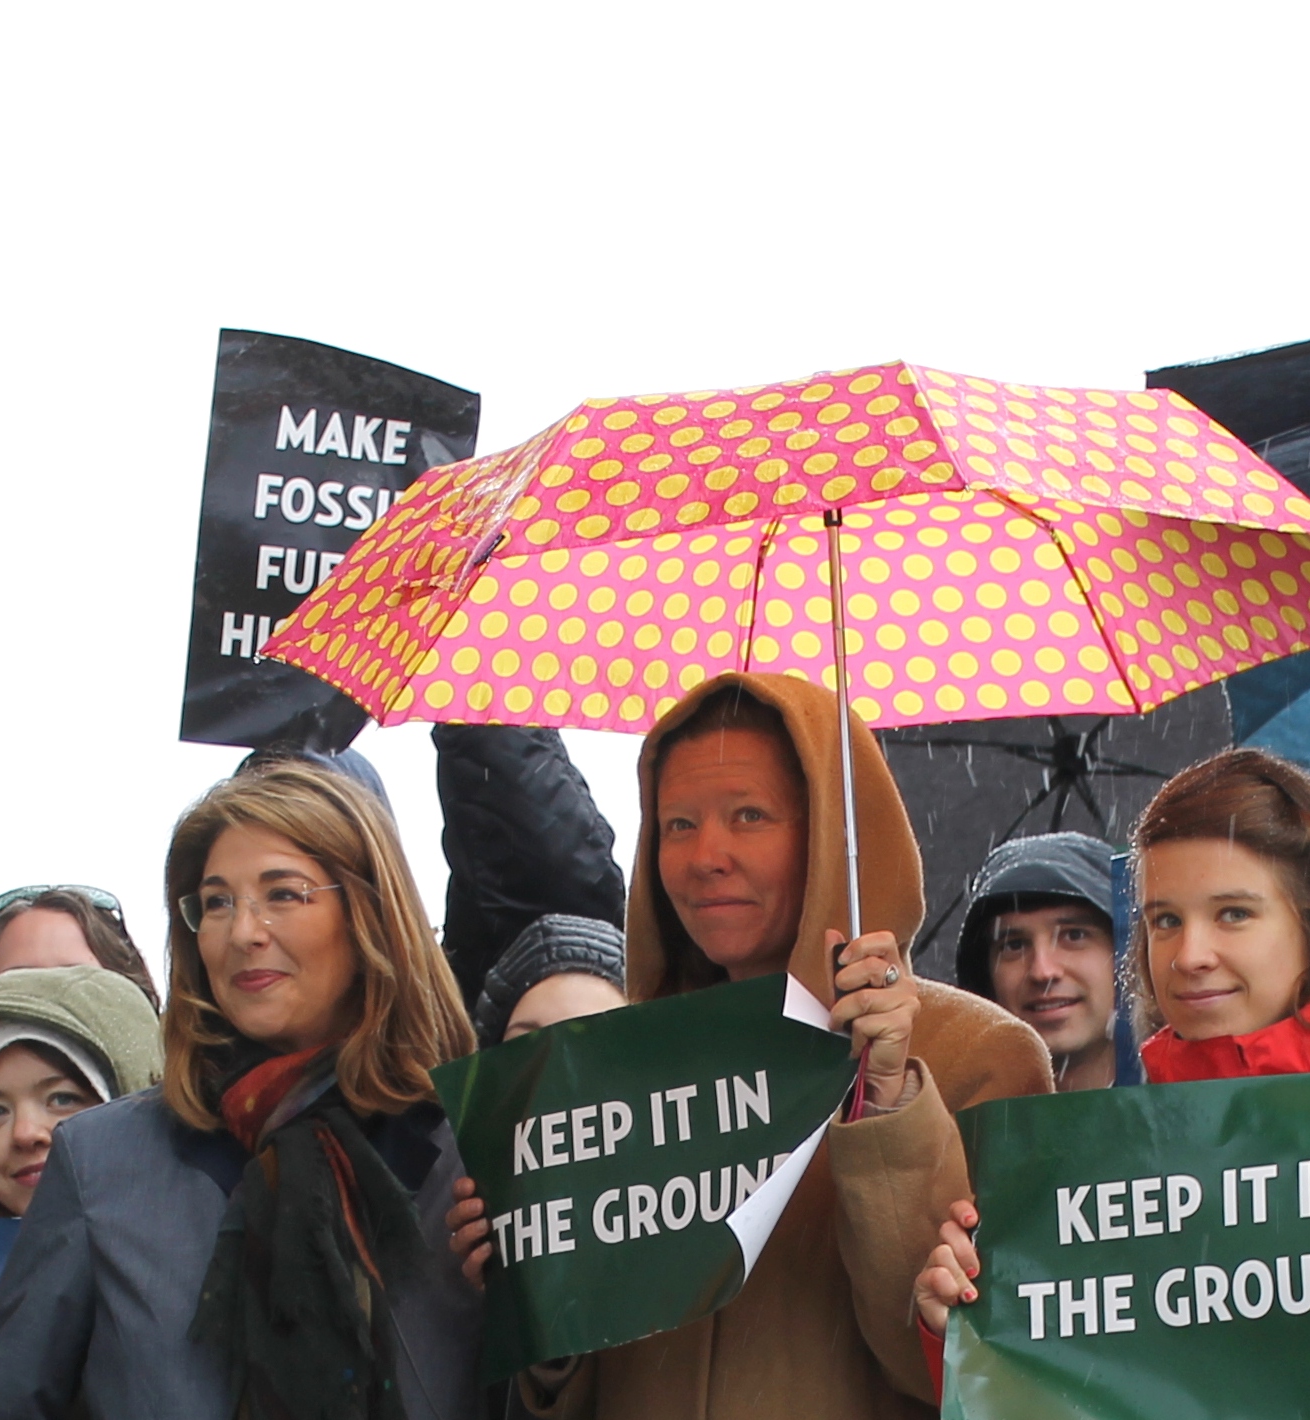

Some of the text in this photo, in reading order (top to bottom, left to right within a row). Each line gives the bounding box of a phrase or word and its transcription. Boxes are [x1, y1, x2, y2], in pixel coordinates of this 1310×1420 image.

[275, 404, 412, 466] MAKE
[254, 473, 406, 530] FOSSI
[513, 1069, 771, 1176] KEEP IT IN
[492, 1152, 792, 1268] THE GROUN
[1055, 1174, 1203, 1245] KEEP
[1222, 1164, 1278, 1227] IT
[1017, 1273, 1137, 1340] THE
